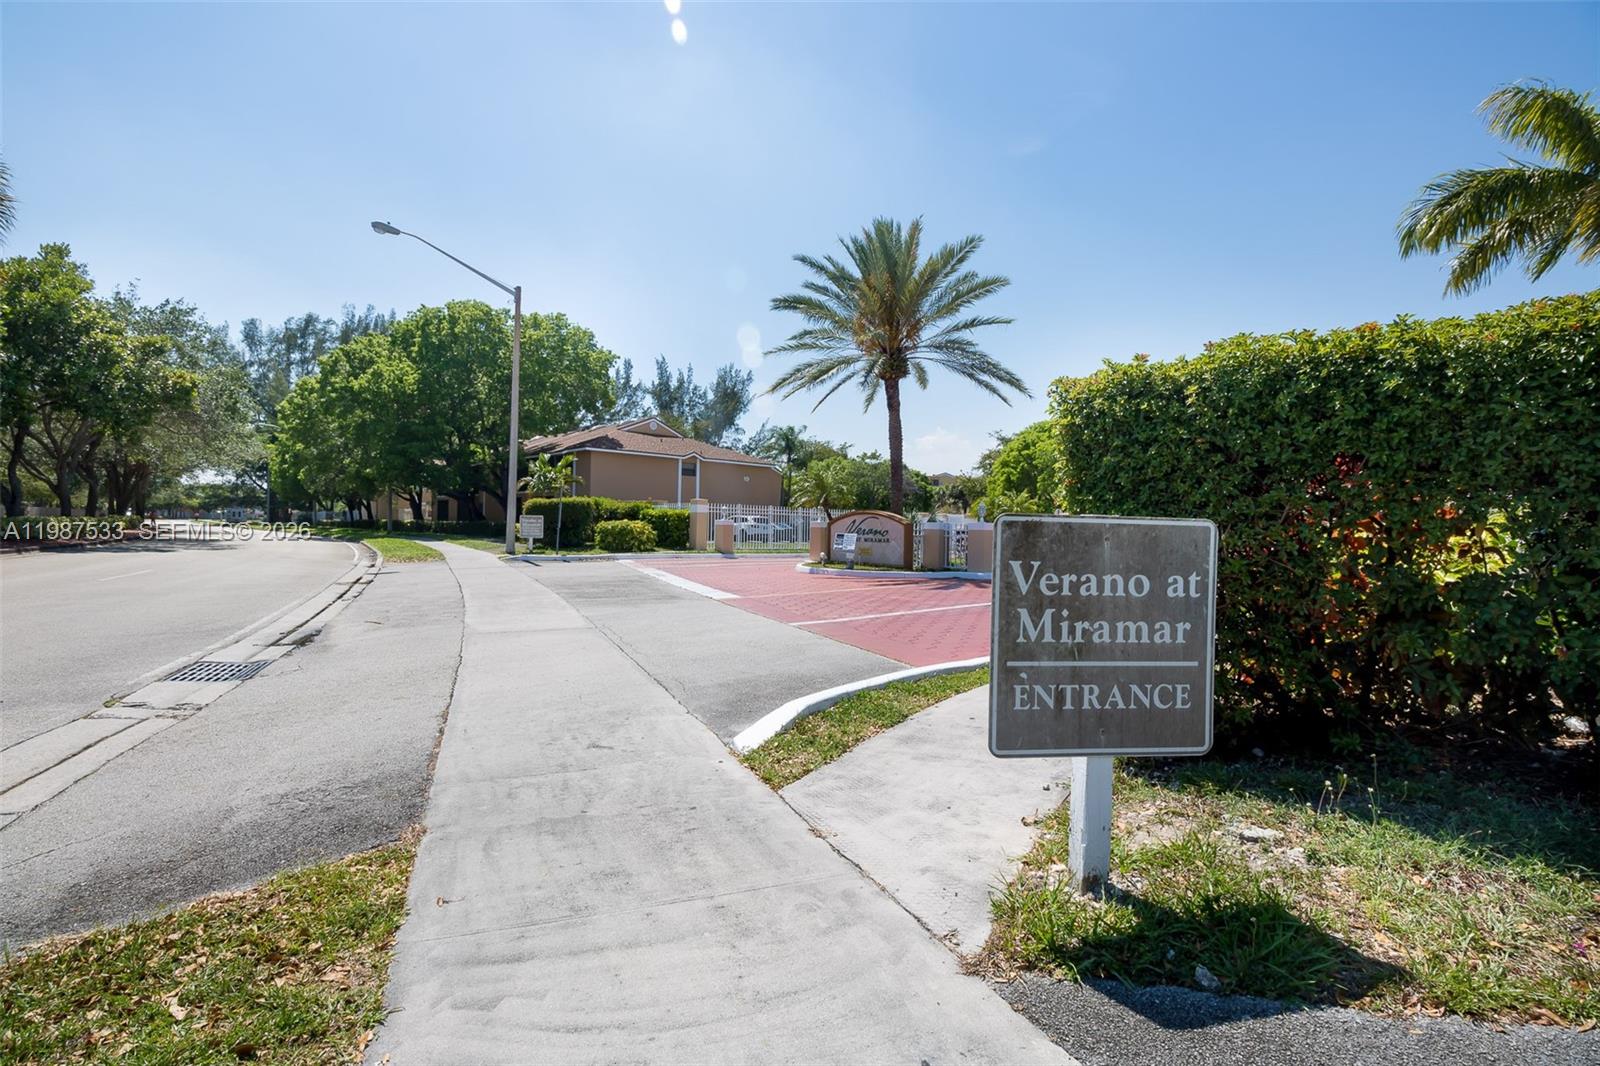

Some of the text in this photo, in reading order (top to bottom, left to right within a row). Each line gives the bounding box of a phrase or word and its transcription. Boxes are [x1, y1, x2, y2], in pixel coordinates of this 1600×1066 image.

[845, 516, 889, 537] Verano
[1009, 560, 1201, 598] Verano at
[1016, 608, 1192, 644] Miramar
